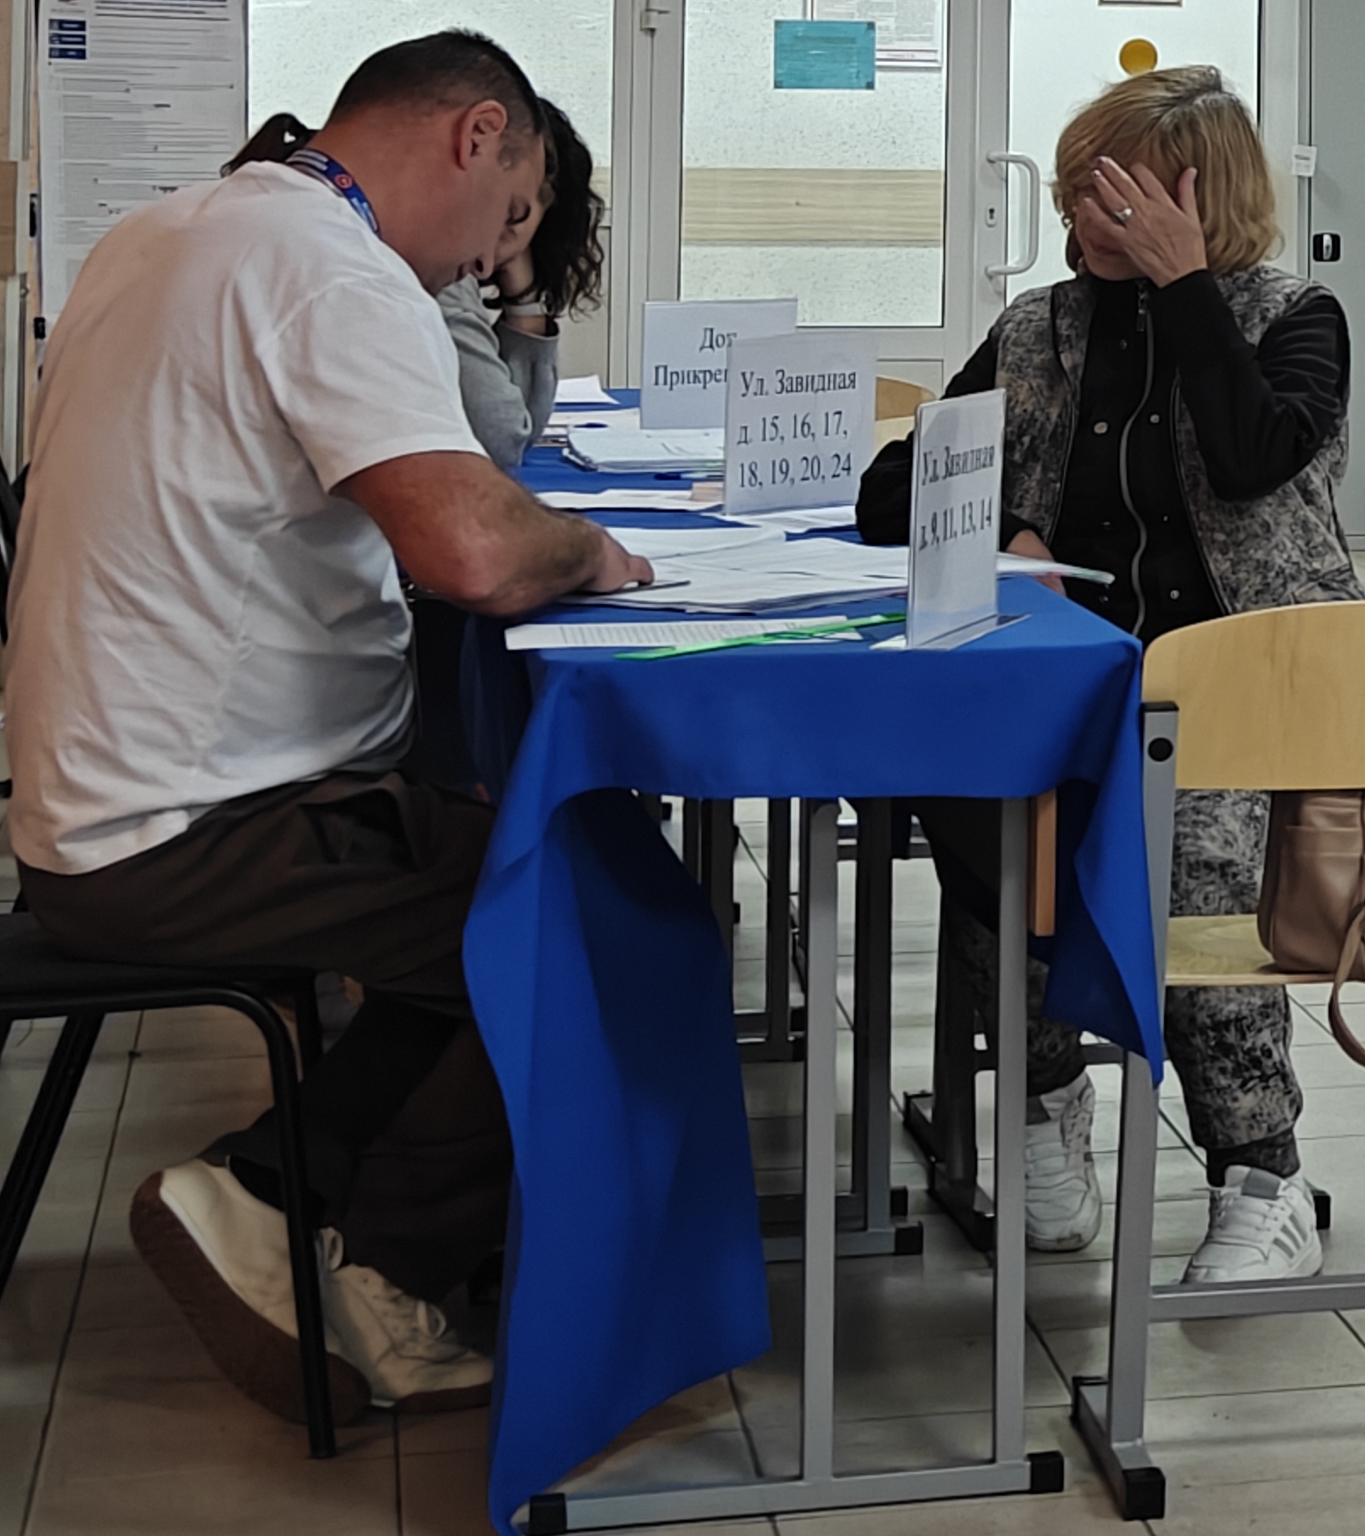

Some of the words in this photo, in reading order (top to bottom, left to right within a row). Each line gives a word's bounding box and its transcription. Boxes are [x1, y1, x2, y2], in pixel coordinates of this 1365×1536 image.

[740, 370, 769, 398] Ул.
[774, 368, 857, 395] Завидная
[761, 415, 785, 445] 15,
[792, 411, 816, 443] 16,
[823, 410, 848, 440] 17,
[771, 457, 795, 487] 19,
[800, 454, 826, 484] 20,
[831, 451, 852, 479] 24
[942, 445, 995, 482] Завидная
[980, 495, 993, 531] 14
